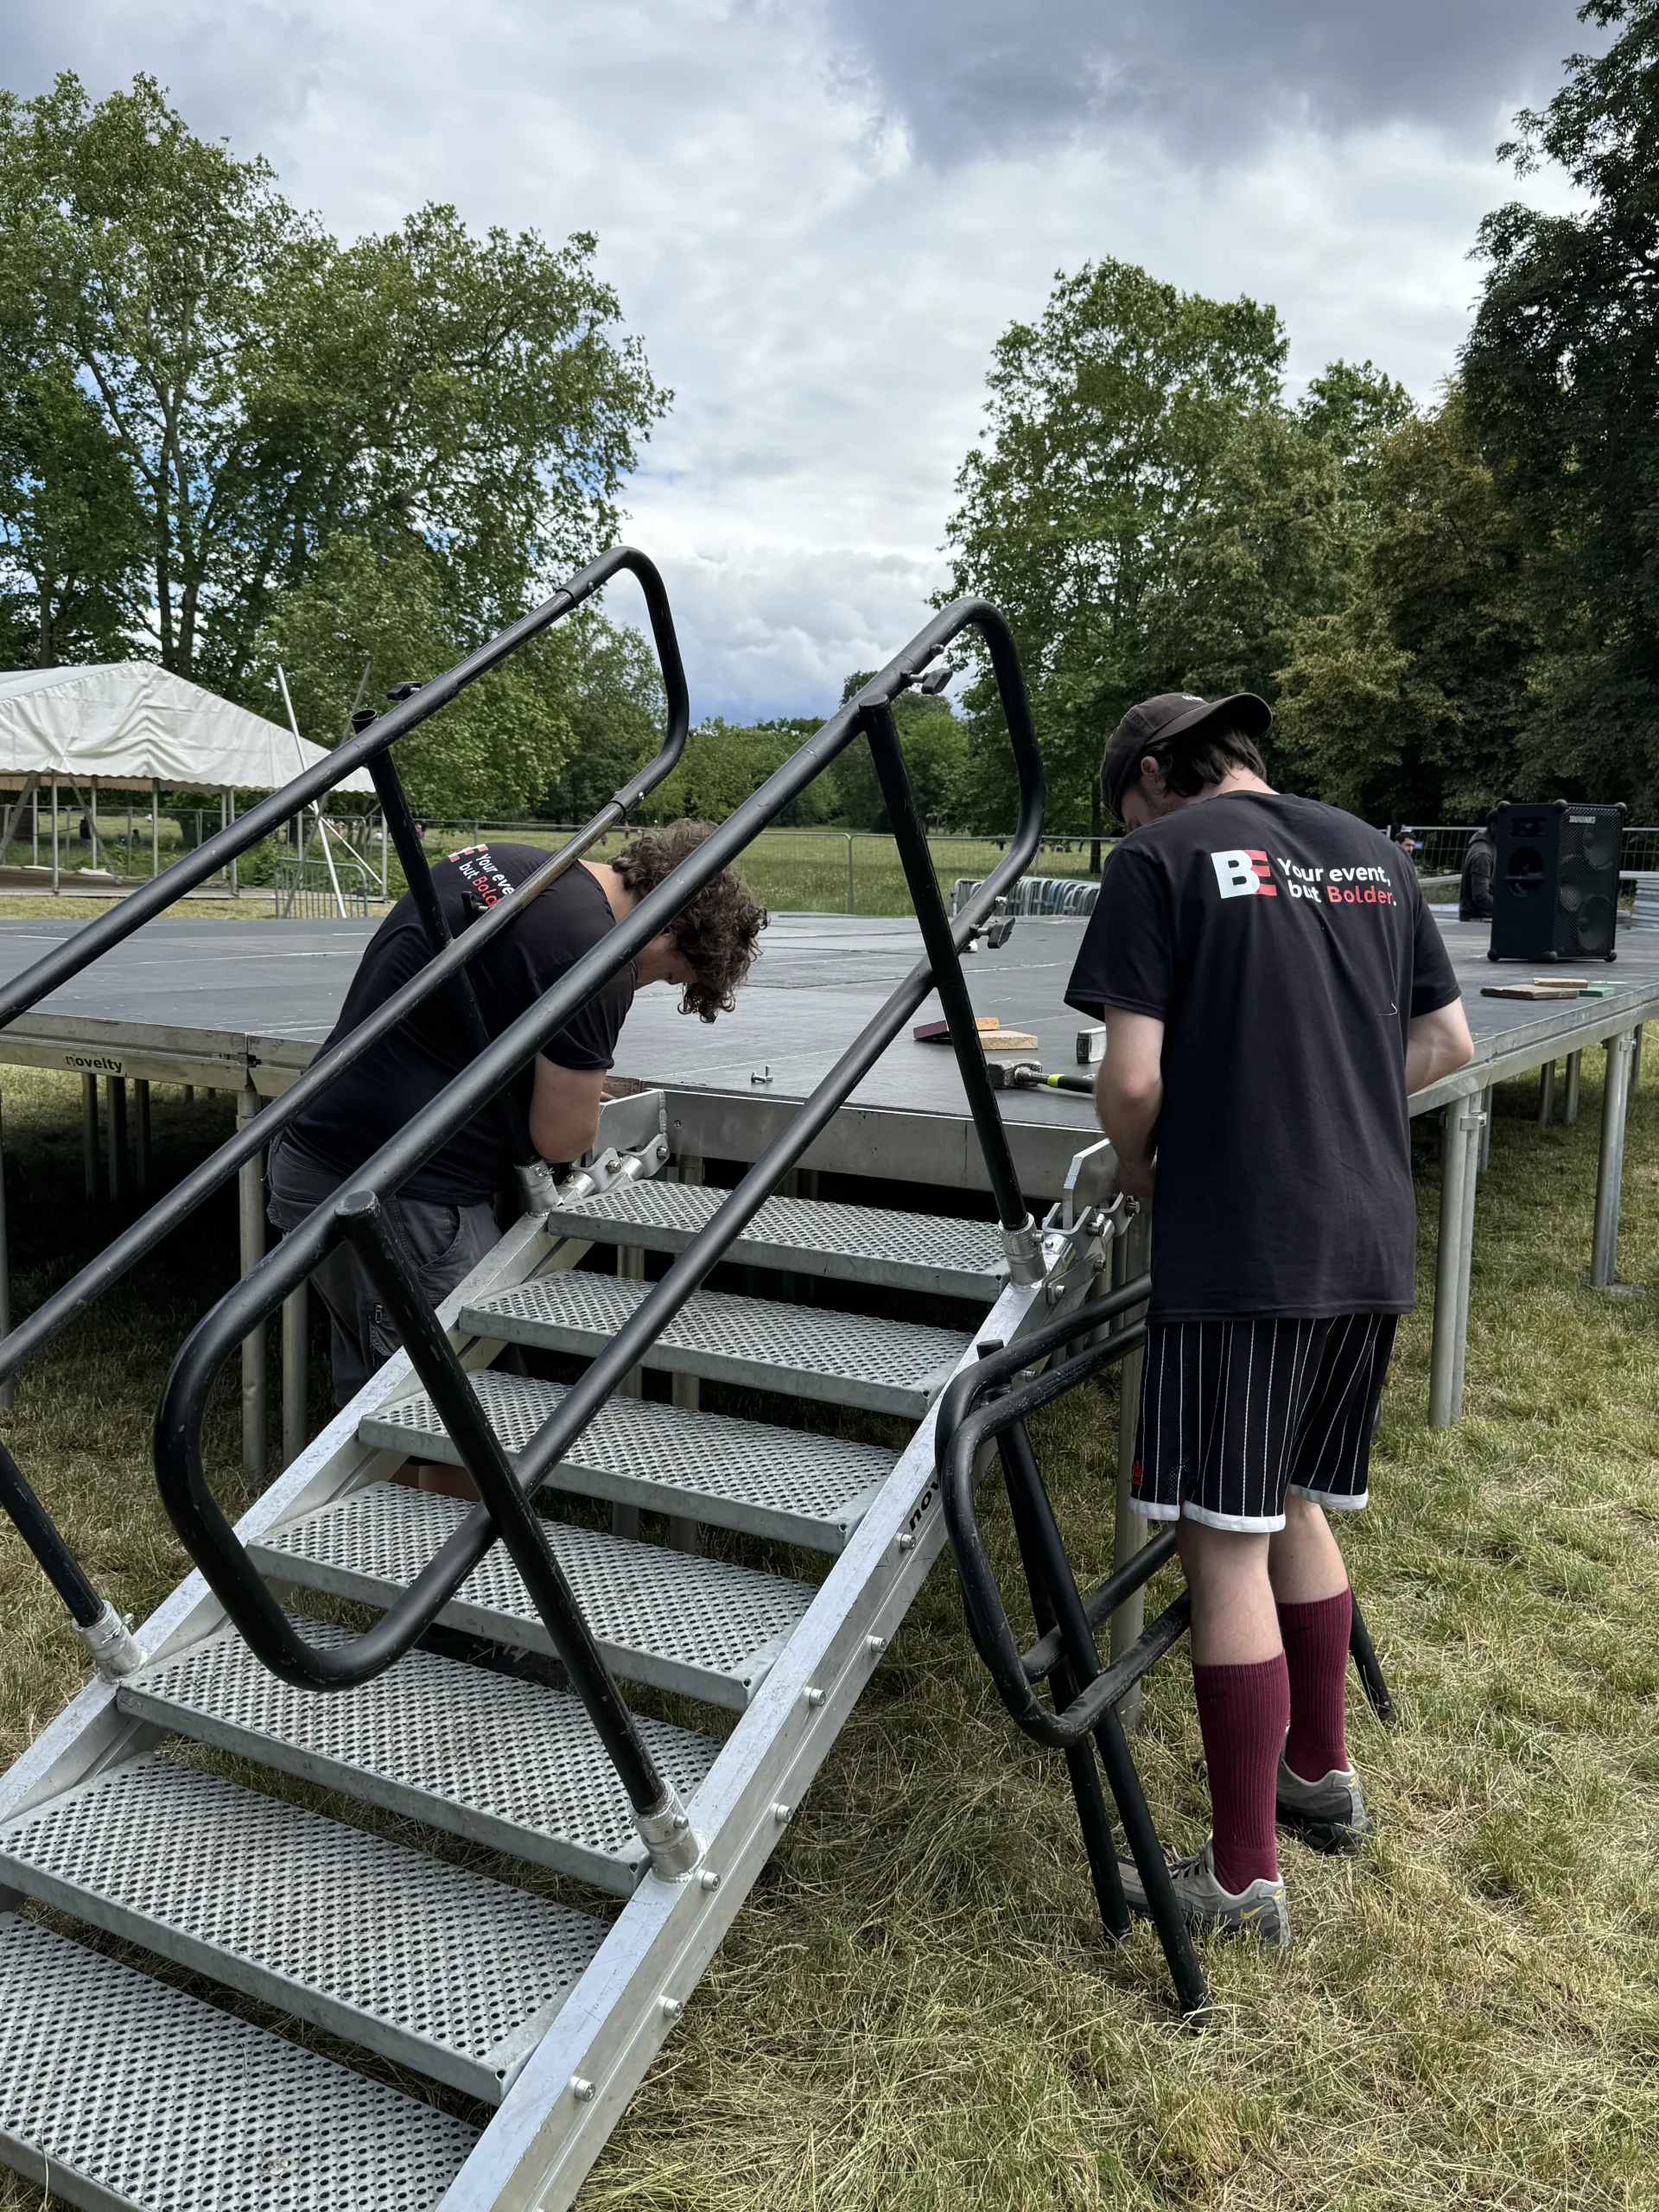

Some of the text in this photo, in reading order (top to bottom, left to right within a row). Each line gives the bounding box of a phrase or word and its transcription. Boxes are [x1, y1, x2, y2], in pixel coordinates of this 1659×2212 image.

[459, 861, 480, 880] but
[475, 853, 499, 874] Your
[1276, 857, 1391, 887] Your event,
[1287, 879, 1397, 906] but Bolder.
[65, 1056, 123, 1073] novelty
